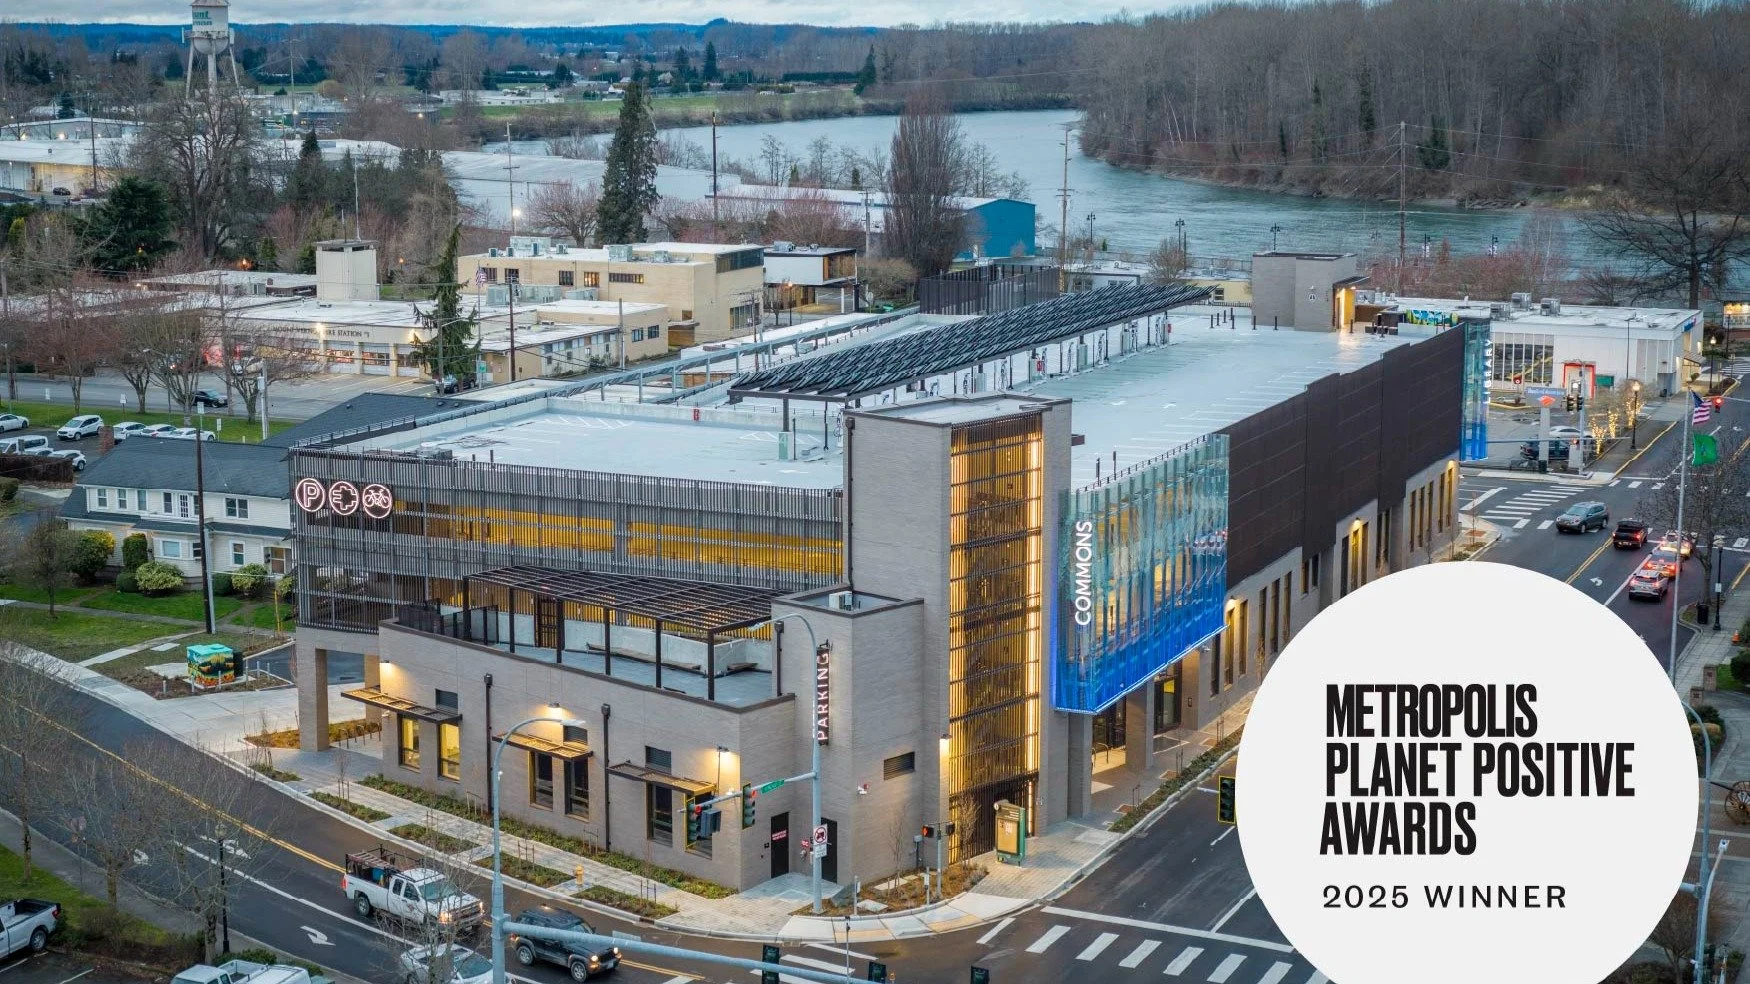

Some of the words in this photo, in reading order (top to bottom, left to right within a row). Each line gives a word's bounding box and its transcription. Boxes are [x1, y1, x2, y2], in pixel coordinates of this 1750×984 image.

[1482, 339, 1493, 404] LIBRARY
[303, 482, 319, 508] P
[1075, 521, 1092, 626] COMMONS
[816, 653, 829, 741] PARKING
